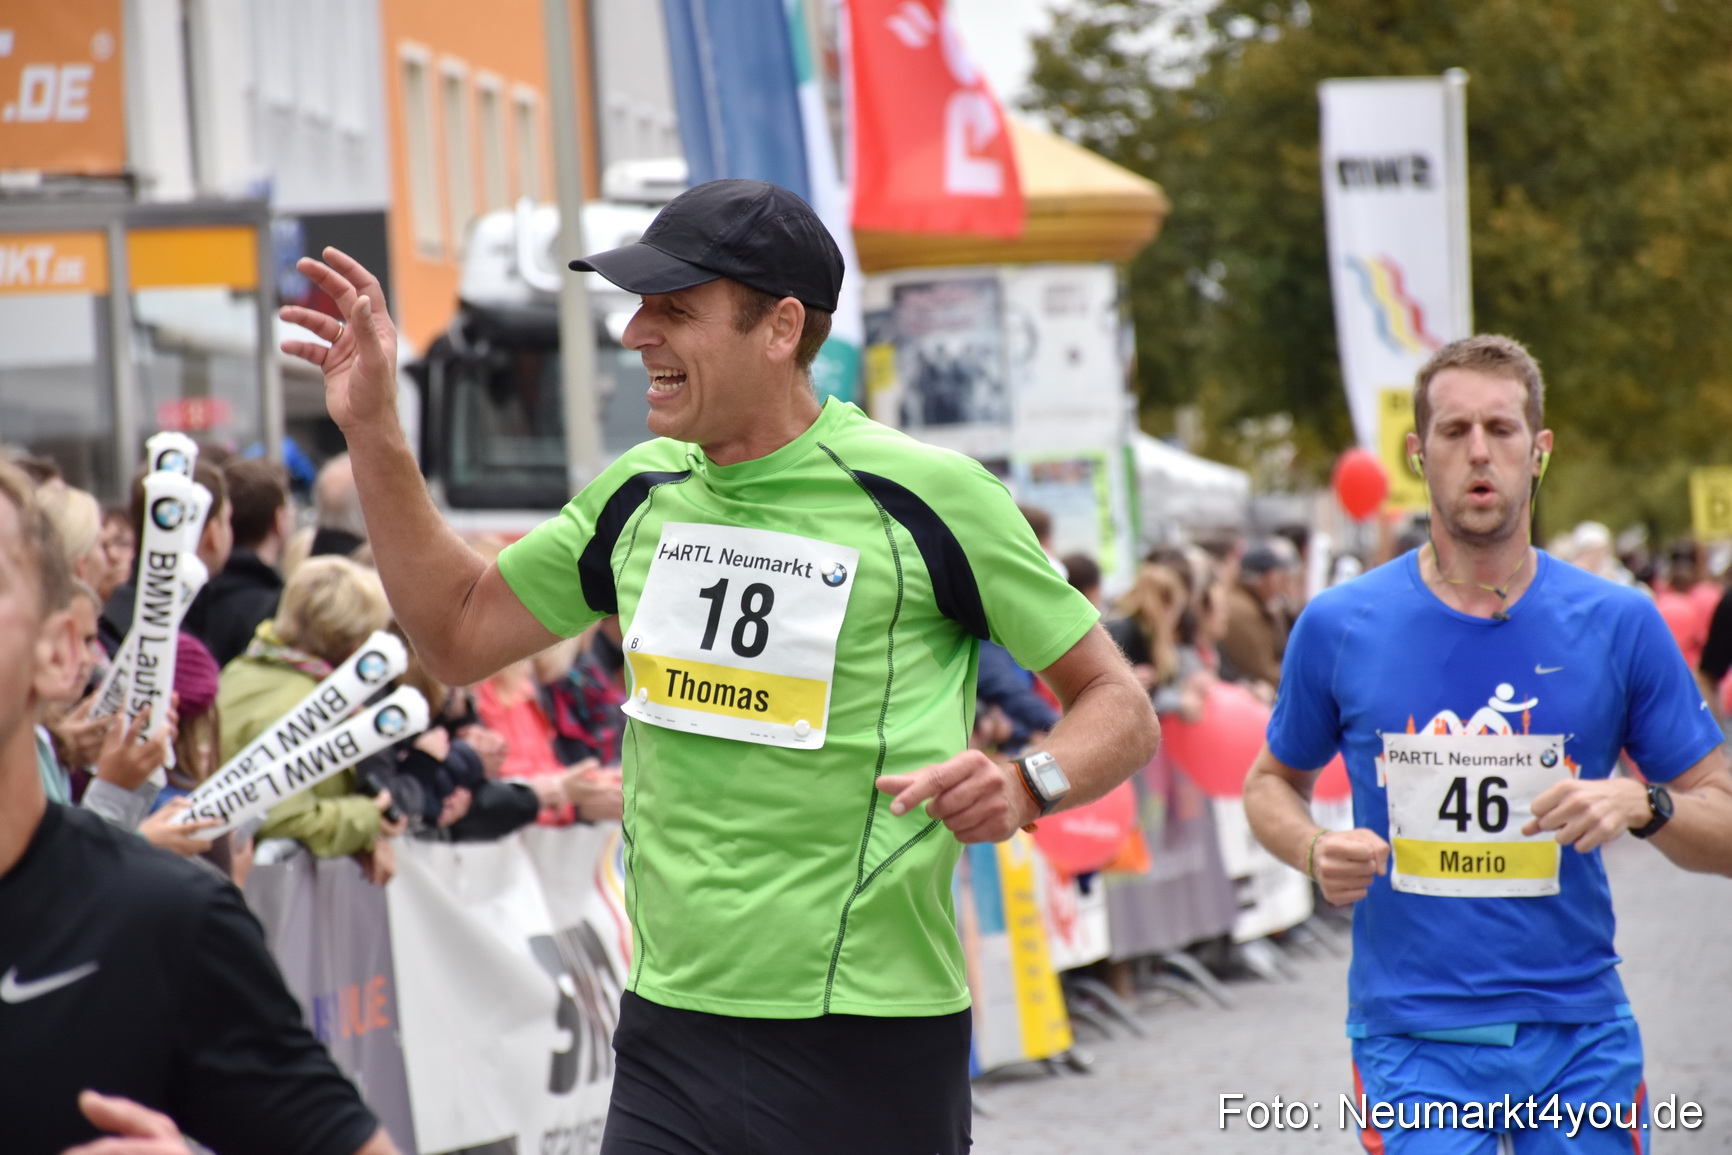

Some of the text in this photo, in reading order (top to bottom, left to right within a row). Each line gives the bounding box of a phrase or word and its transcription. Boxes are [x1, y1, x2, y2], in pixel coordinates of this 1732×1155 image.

[141, 551, 178, 628] BMW
[718, 547, 813, 579] Neumarkt
[698, 577, 775, 659] 18
[276, 685, 348, 752] BMW
[665, 668, 770, 712] Thomas
[283, 731, 360, 790] BMW
[1389, 750, 1443, 765] PARTL
[1449, 752, 1533, 766] Neumarkt
[1438, 776, 1509, 834] 46
[1440, 850, 1506, 873] Mario
